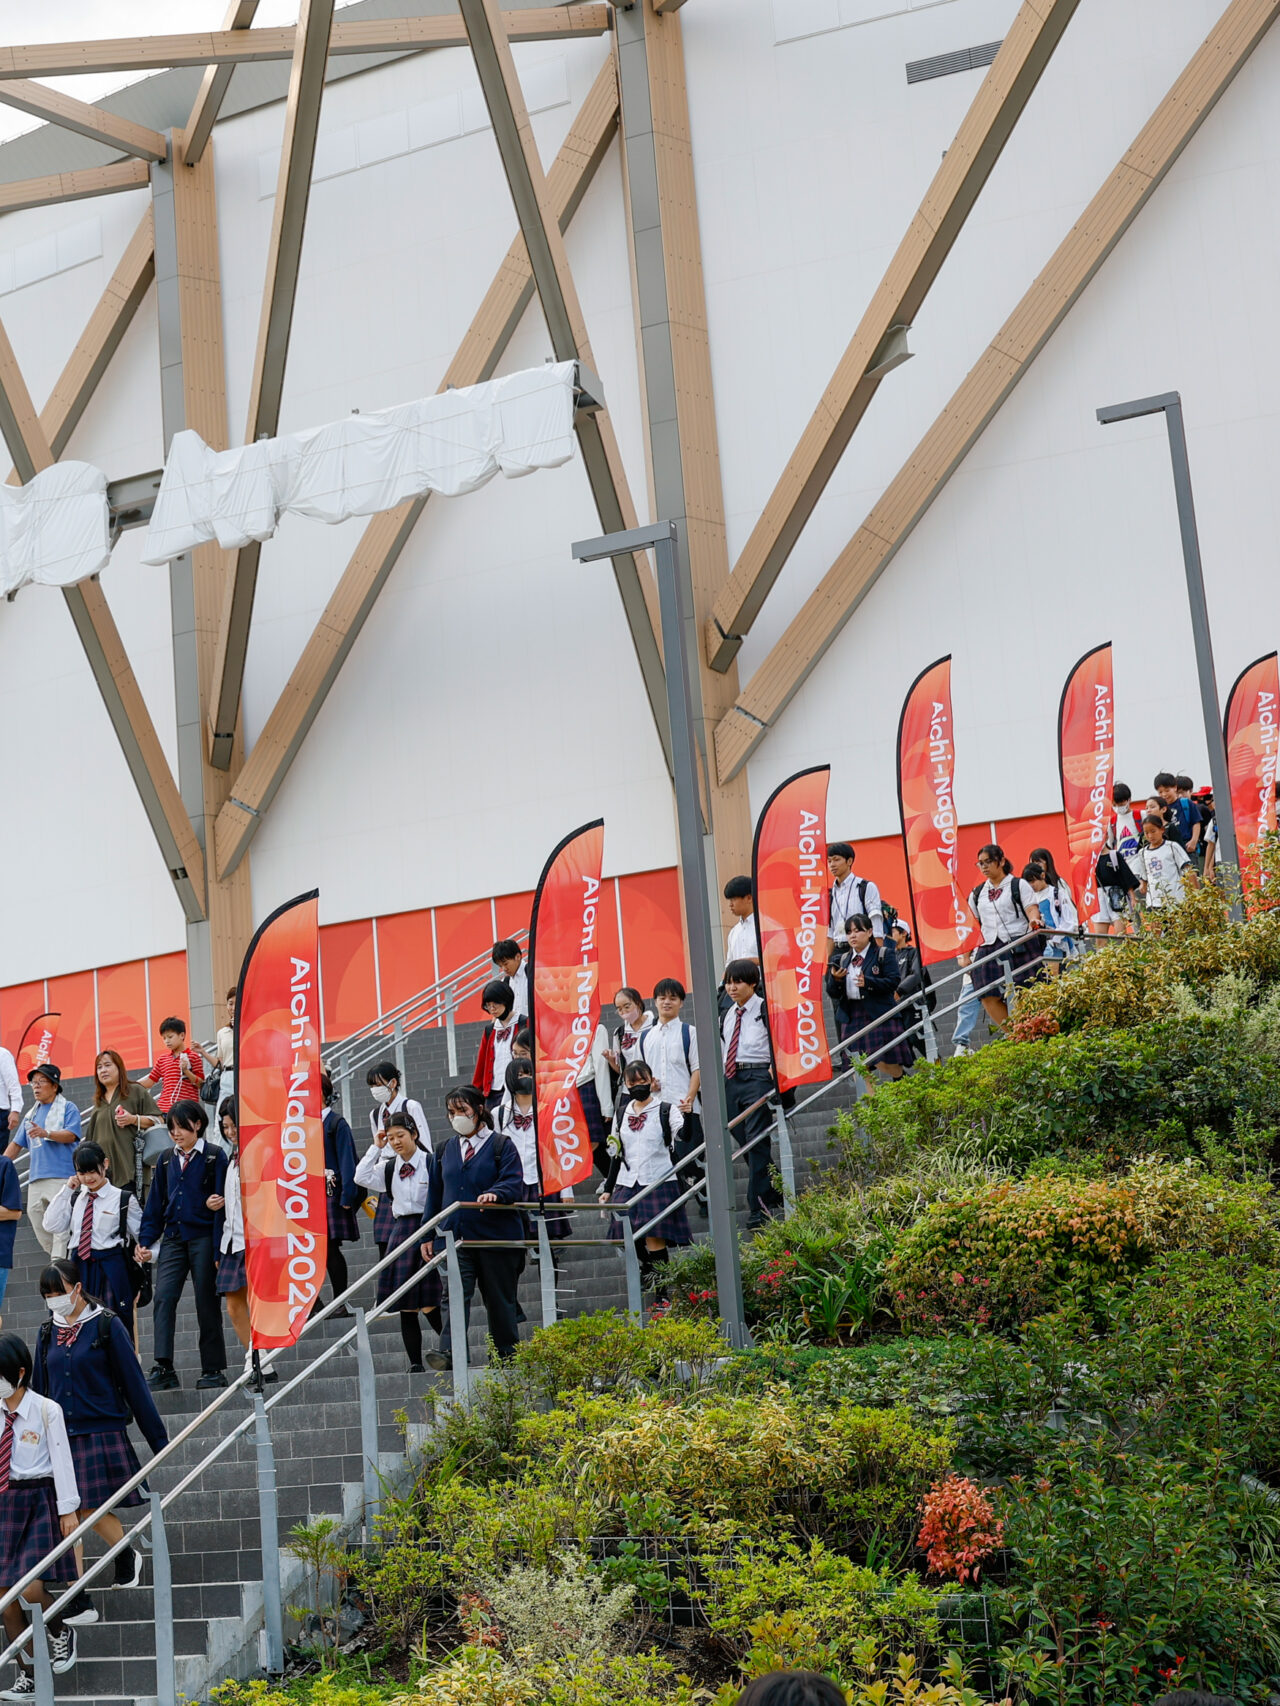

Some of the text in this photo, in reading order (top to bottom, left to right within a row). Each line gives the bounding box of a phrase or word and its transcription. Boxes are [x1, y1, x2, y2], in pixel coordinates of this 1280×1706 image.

[1089, 684, 1112, 843] Aichi-Nagoya
[1258, 691, 1278, 838] Aichi-Nagoya
[552, 875, 600, 1171] Aichi-Nagoya 2026
[796, 809, 823, 1070] Aichi-Nagoya 2026
[277, 957, 311, 1219] Aichi-Nagoya
